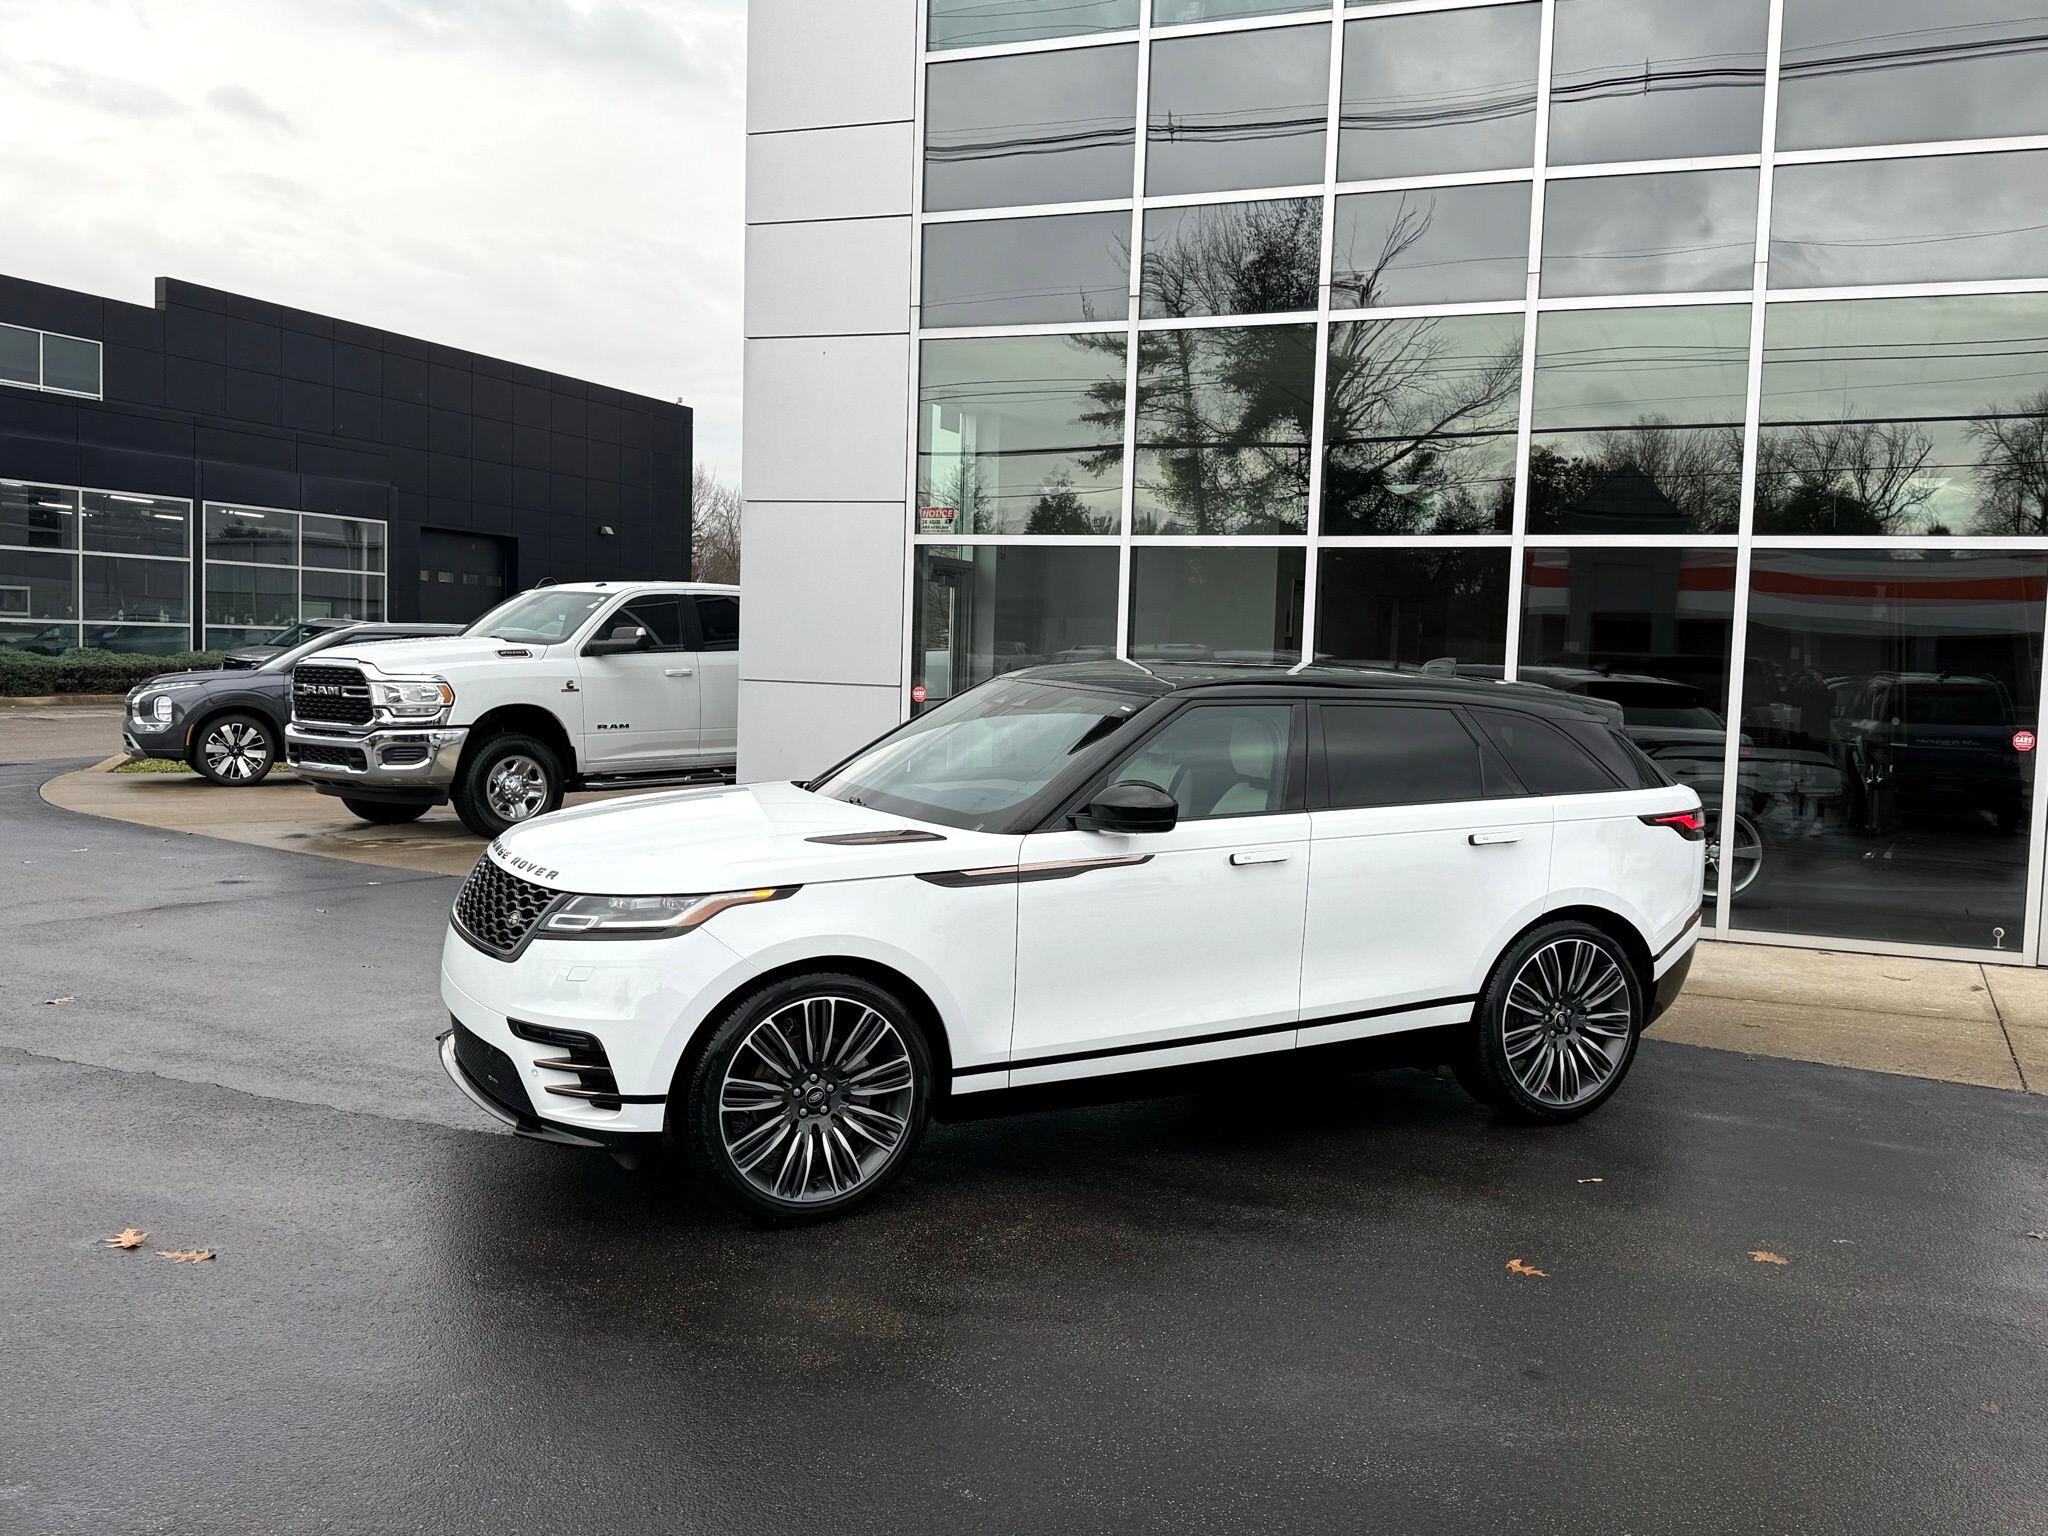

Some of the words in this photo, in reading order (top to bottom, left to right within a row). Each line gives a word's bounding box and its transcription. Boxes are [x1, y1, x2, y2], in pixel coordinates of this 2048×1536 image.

[922, 509, 954, 518] NOTICE
[304, 685, 339, 695] RAM
[510, 857, 559, 880] ROVER
